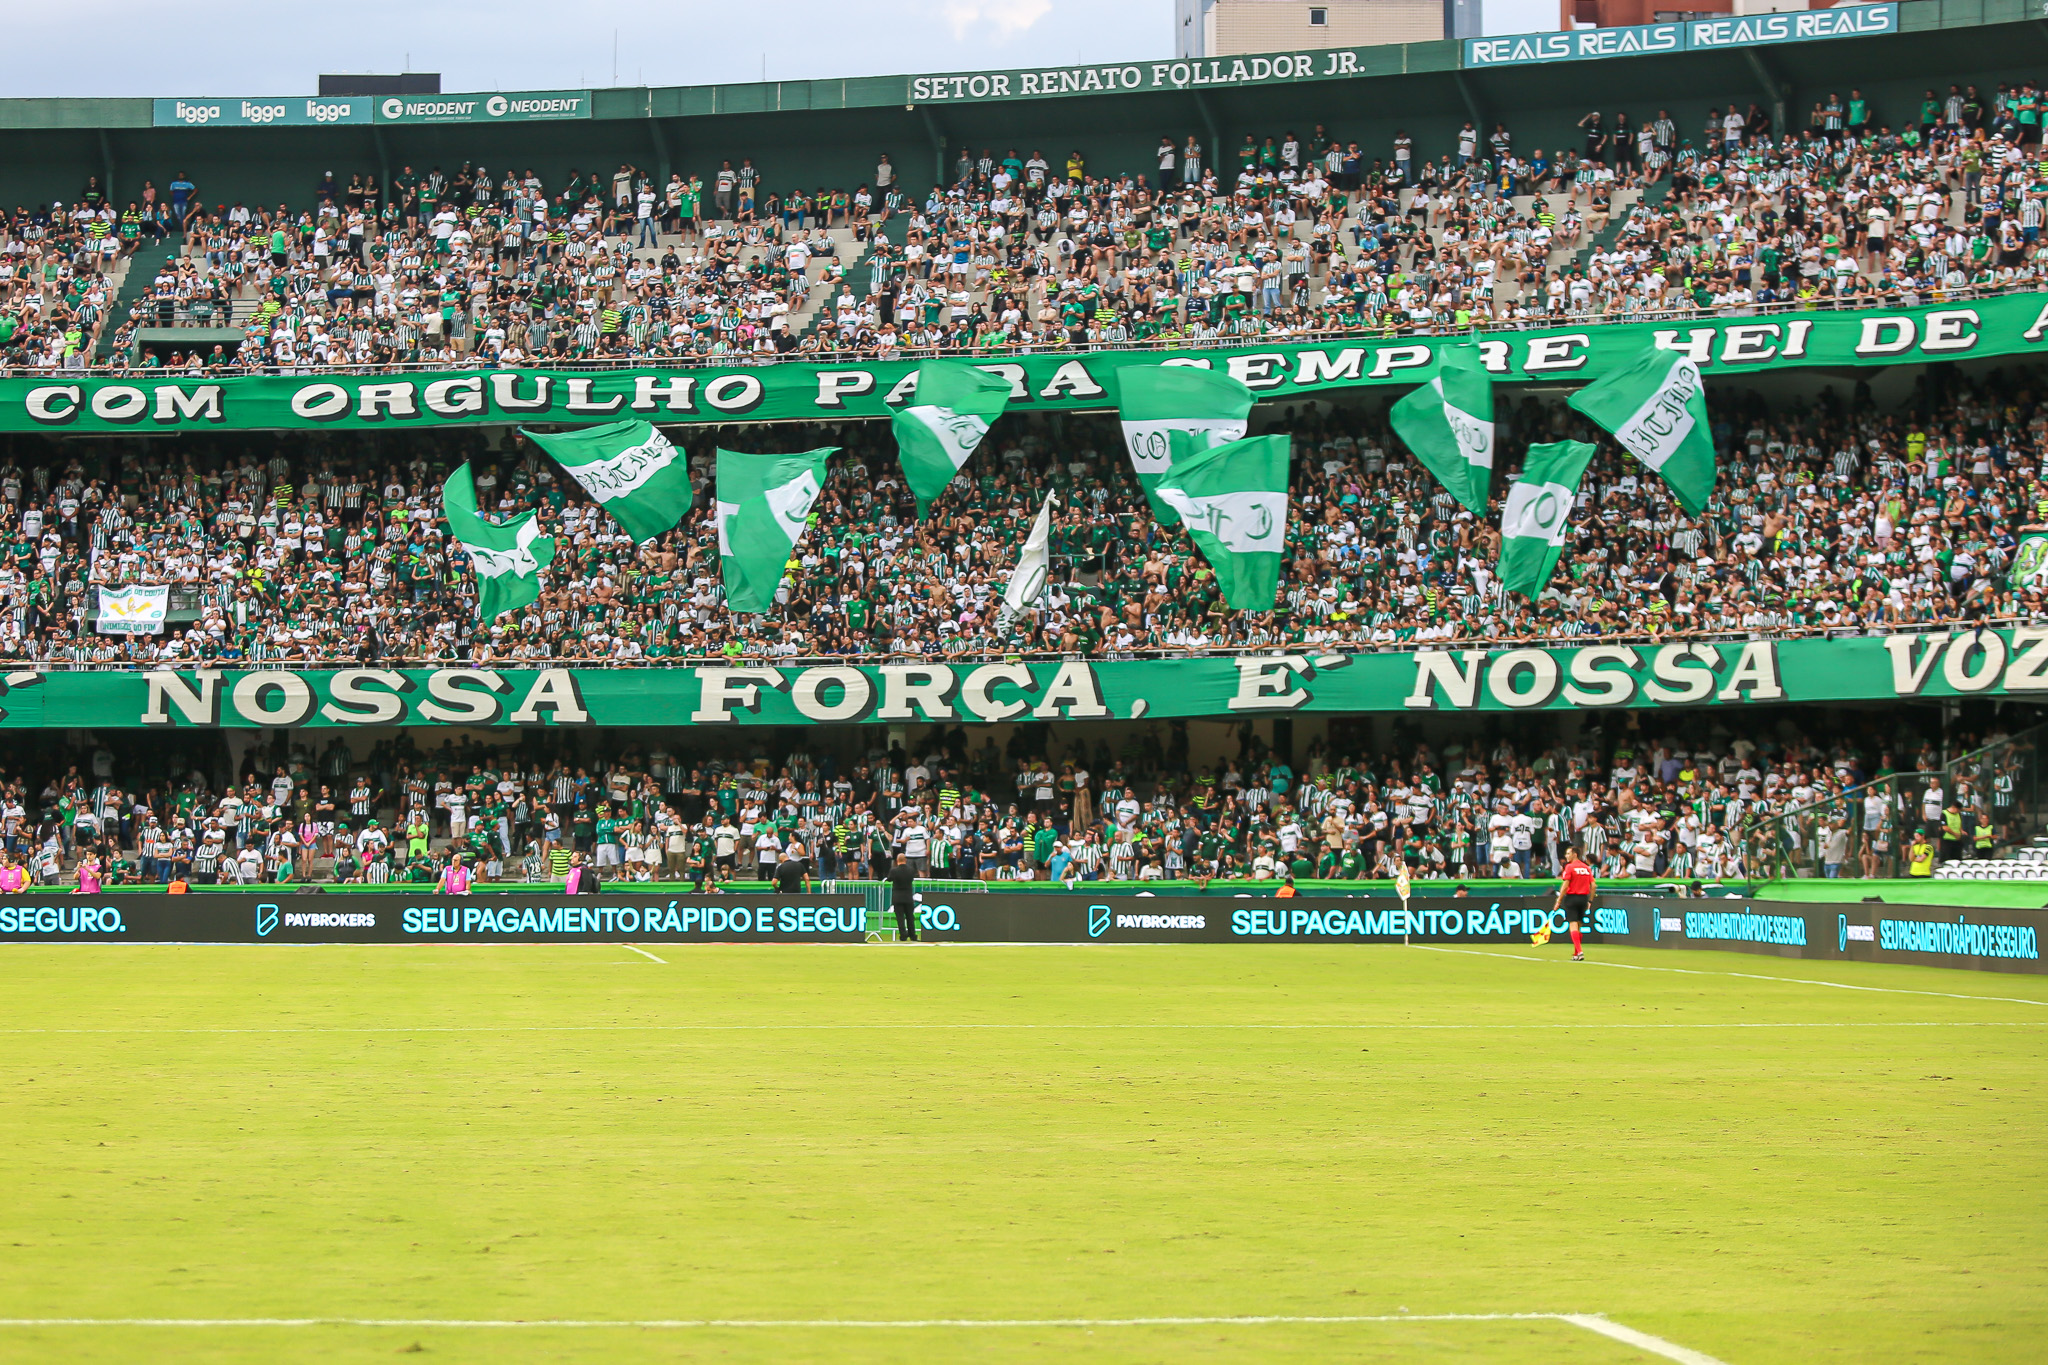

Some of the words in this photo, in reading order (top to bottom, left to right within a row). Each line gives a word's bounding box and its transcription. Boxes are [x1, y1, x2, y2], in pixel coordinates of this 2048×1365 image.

[1693, 16, 1790, 46] REALS
[1796, 7, 1890, 38] REALS
[1472, 35, 1570, 64] REALS
[1578, 26, 1677, 57] REALS
[913, 74, 1011, 100] SETOR
[1020, 66, 1142, 96] RENATO
[1152, 54, 1314, 88] FOLLADOR
[1322, 51, 1366, 75] JR.
[176, 101, 221, 124] ligga
[241, 100, 286, 123] ligga
[306, 100, 351, 122] ligga
[25, 385, 222, 420] COM
[291, 373, 763, 417] ORGULHO
[1652, 320, 1813, 363] HEI
[1855, 308, 1980, 354] DE
[140, 668, 590, 726] NOSSA
[1405, 641, 1783, 709] NOSSA
[1573, 867, 1591, 876] TCL
[0, 906, 126, 933] SEGURO.
[284, 912, 376, 928] PAYBROKERS
[402, 907, 459, 933] SEU
[463, 907, 640, 933] PAGAMENTO
[643, 900, 752, 933] RÁPIDO
[756, 906, 775, 933] E
[1116, 913, 1206, 929] PAYBROKERS
[1231, 909, 1287, 936] SEU
[1290, 909, 1463, 936] PAGAMENTO
[1466, 903, 1570, 935] RÁPIDO
[1685, 911, 1700, 939] SEU
[1879, 919, 1899, 950] SEU
[1899, 919, 1952, 954] PAGAMENTO
[1952, 915, 1988, 957] RÁPIDO
[1995, 924, 2039, 960] SEGURO.
